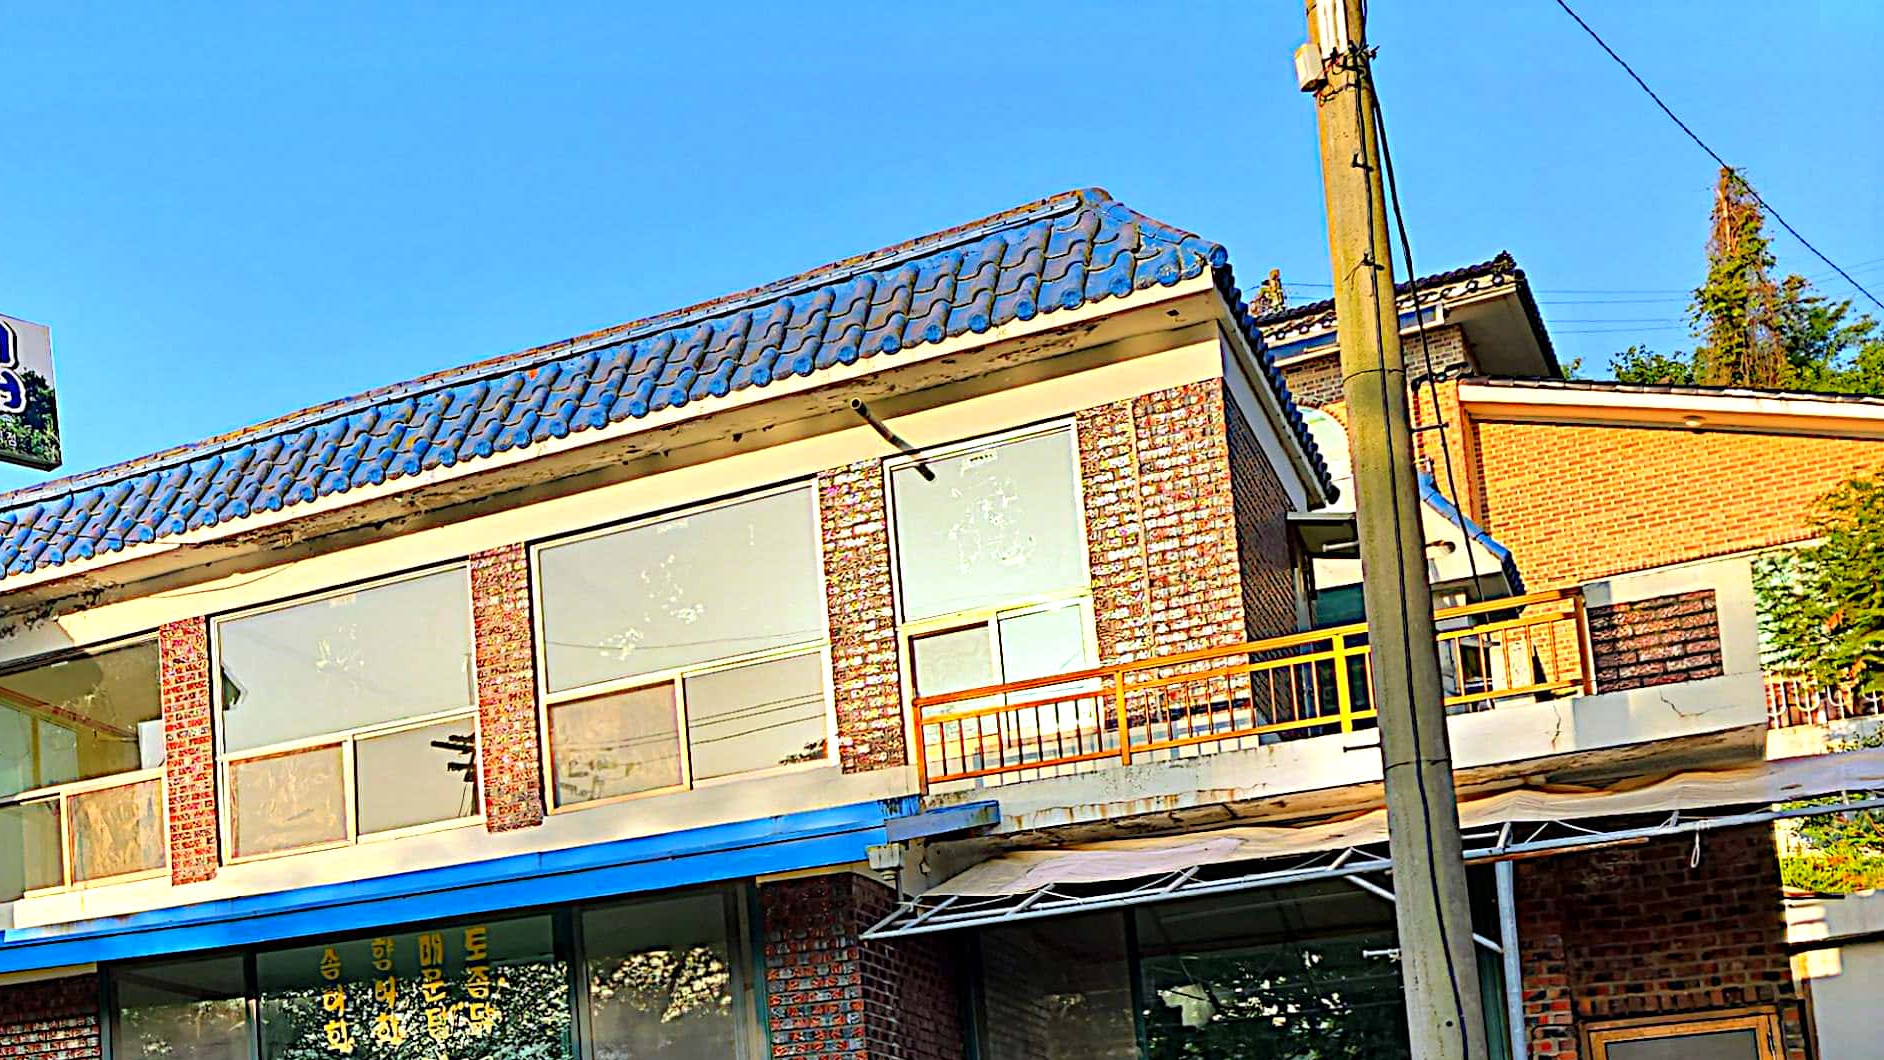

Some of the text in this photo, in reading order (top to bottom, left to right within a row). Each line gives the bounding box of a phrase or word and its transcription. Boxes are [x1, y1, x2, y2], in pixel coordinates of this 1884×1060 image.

[320, 946, 356, 1053] 송어회
[372, 936, 407, 1046] 향어회
[419, 931, 453, 1041] 매운탕
[465, 926, 494, 1036] 토종닭
